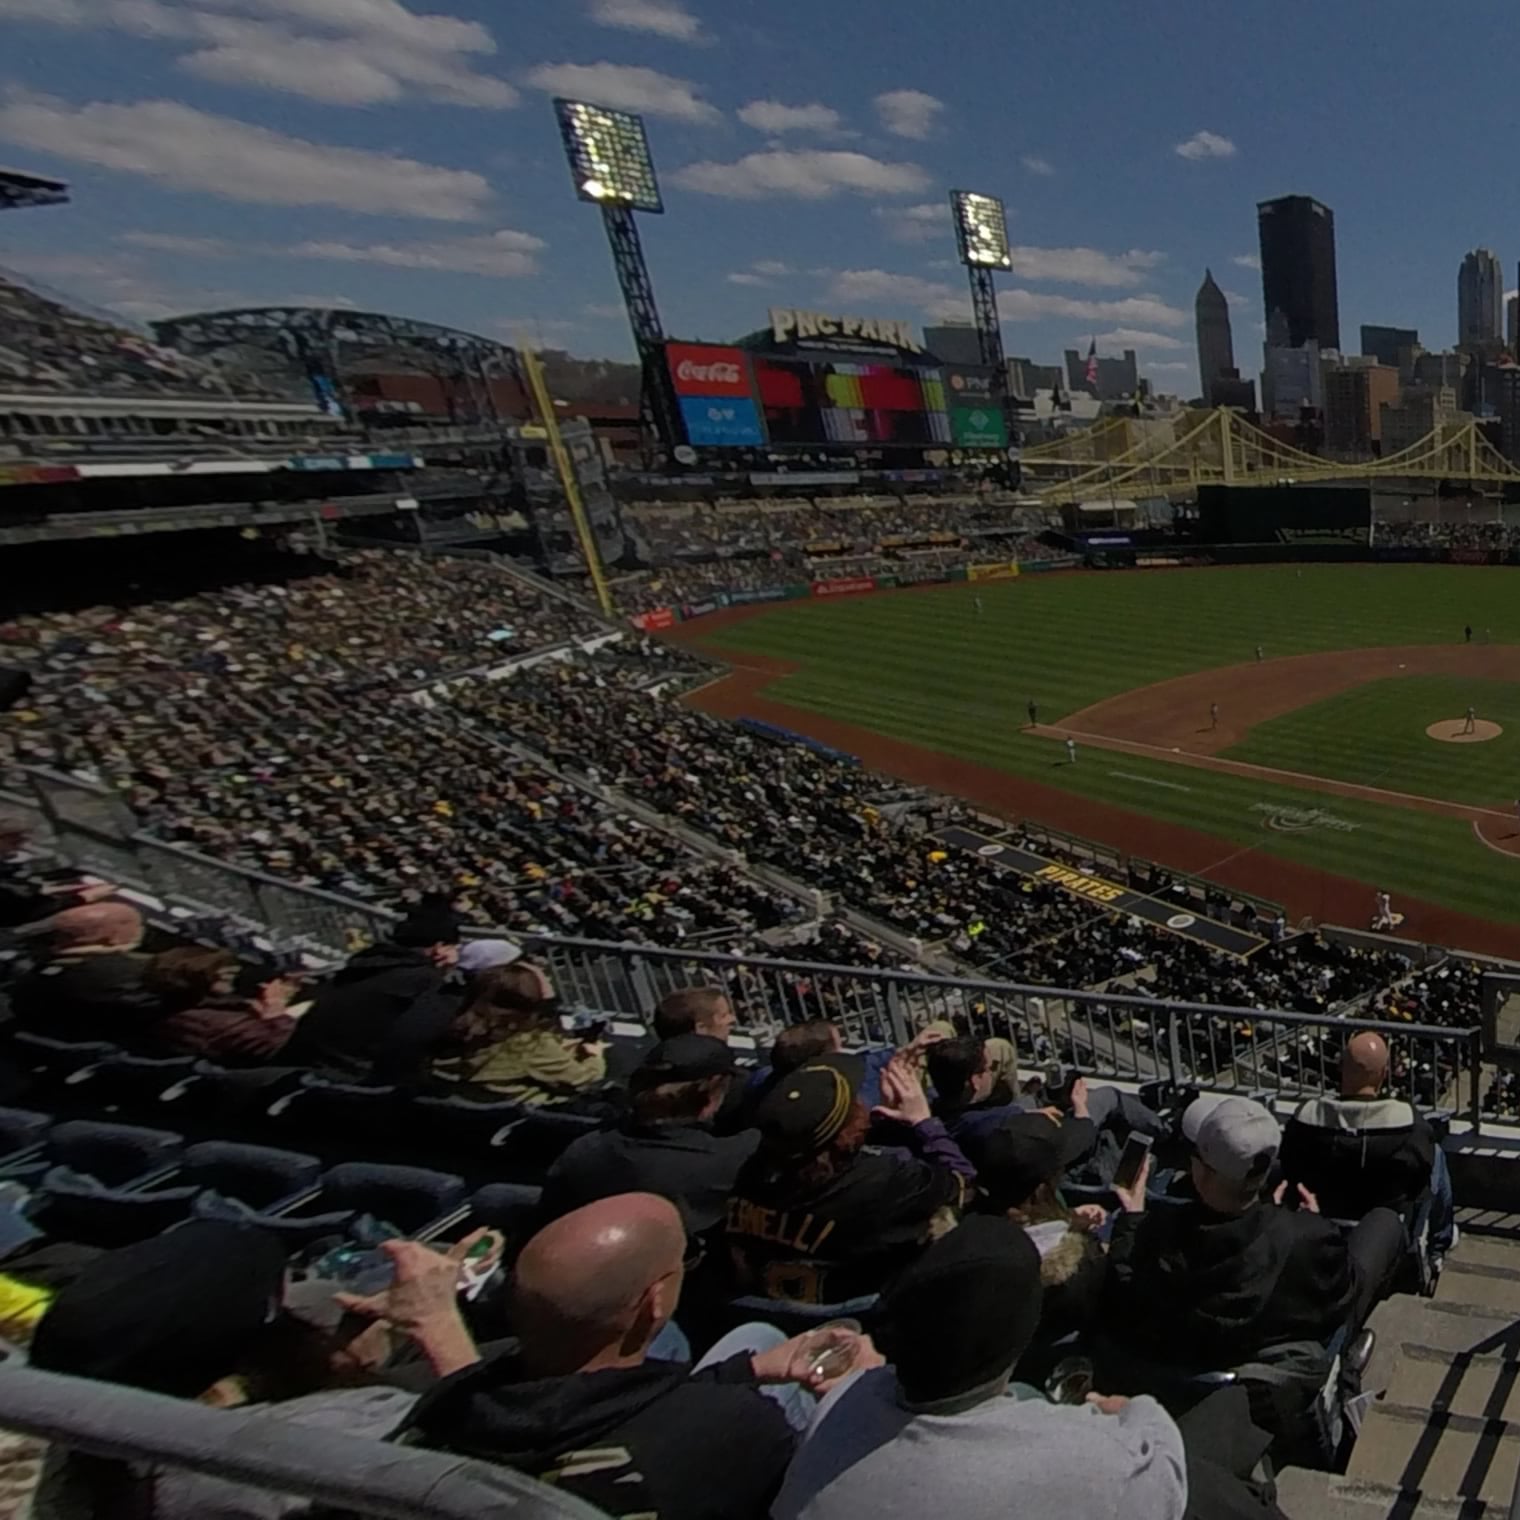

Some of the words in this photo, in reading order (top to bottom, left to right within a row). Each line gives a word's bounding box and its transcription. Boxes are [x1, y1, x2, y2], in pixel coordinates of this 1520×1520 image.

[770, 309, 838, 343] PNC
[842, 317, 923, 355] PARK
[1035, 864, 1126, 901] PIRATES
